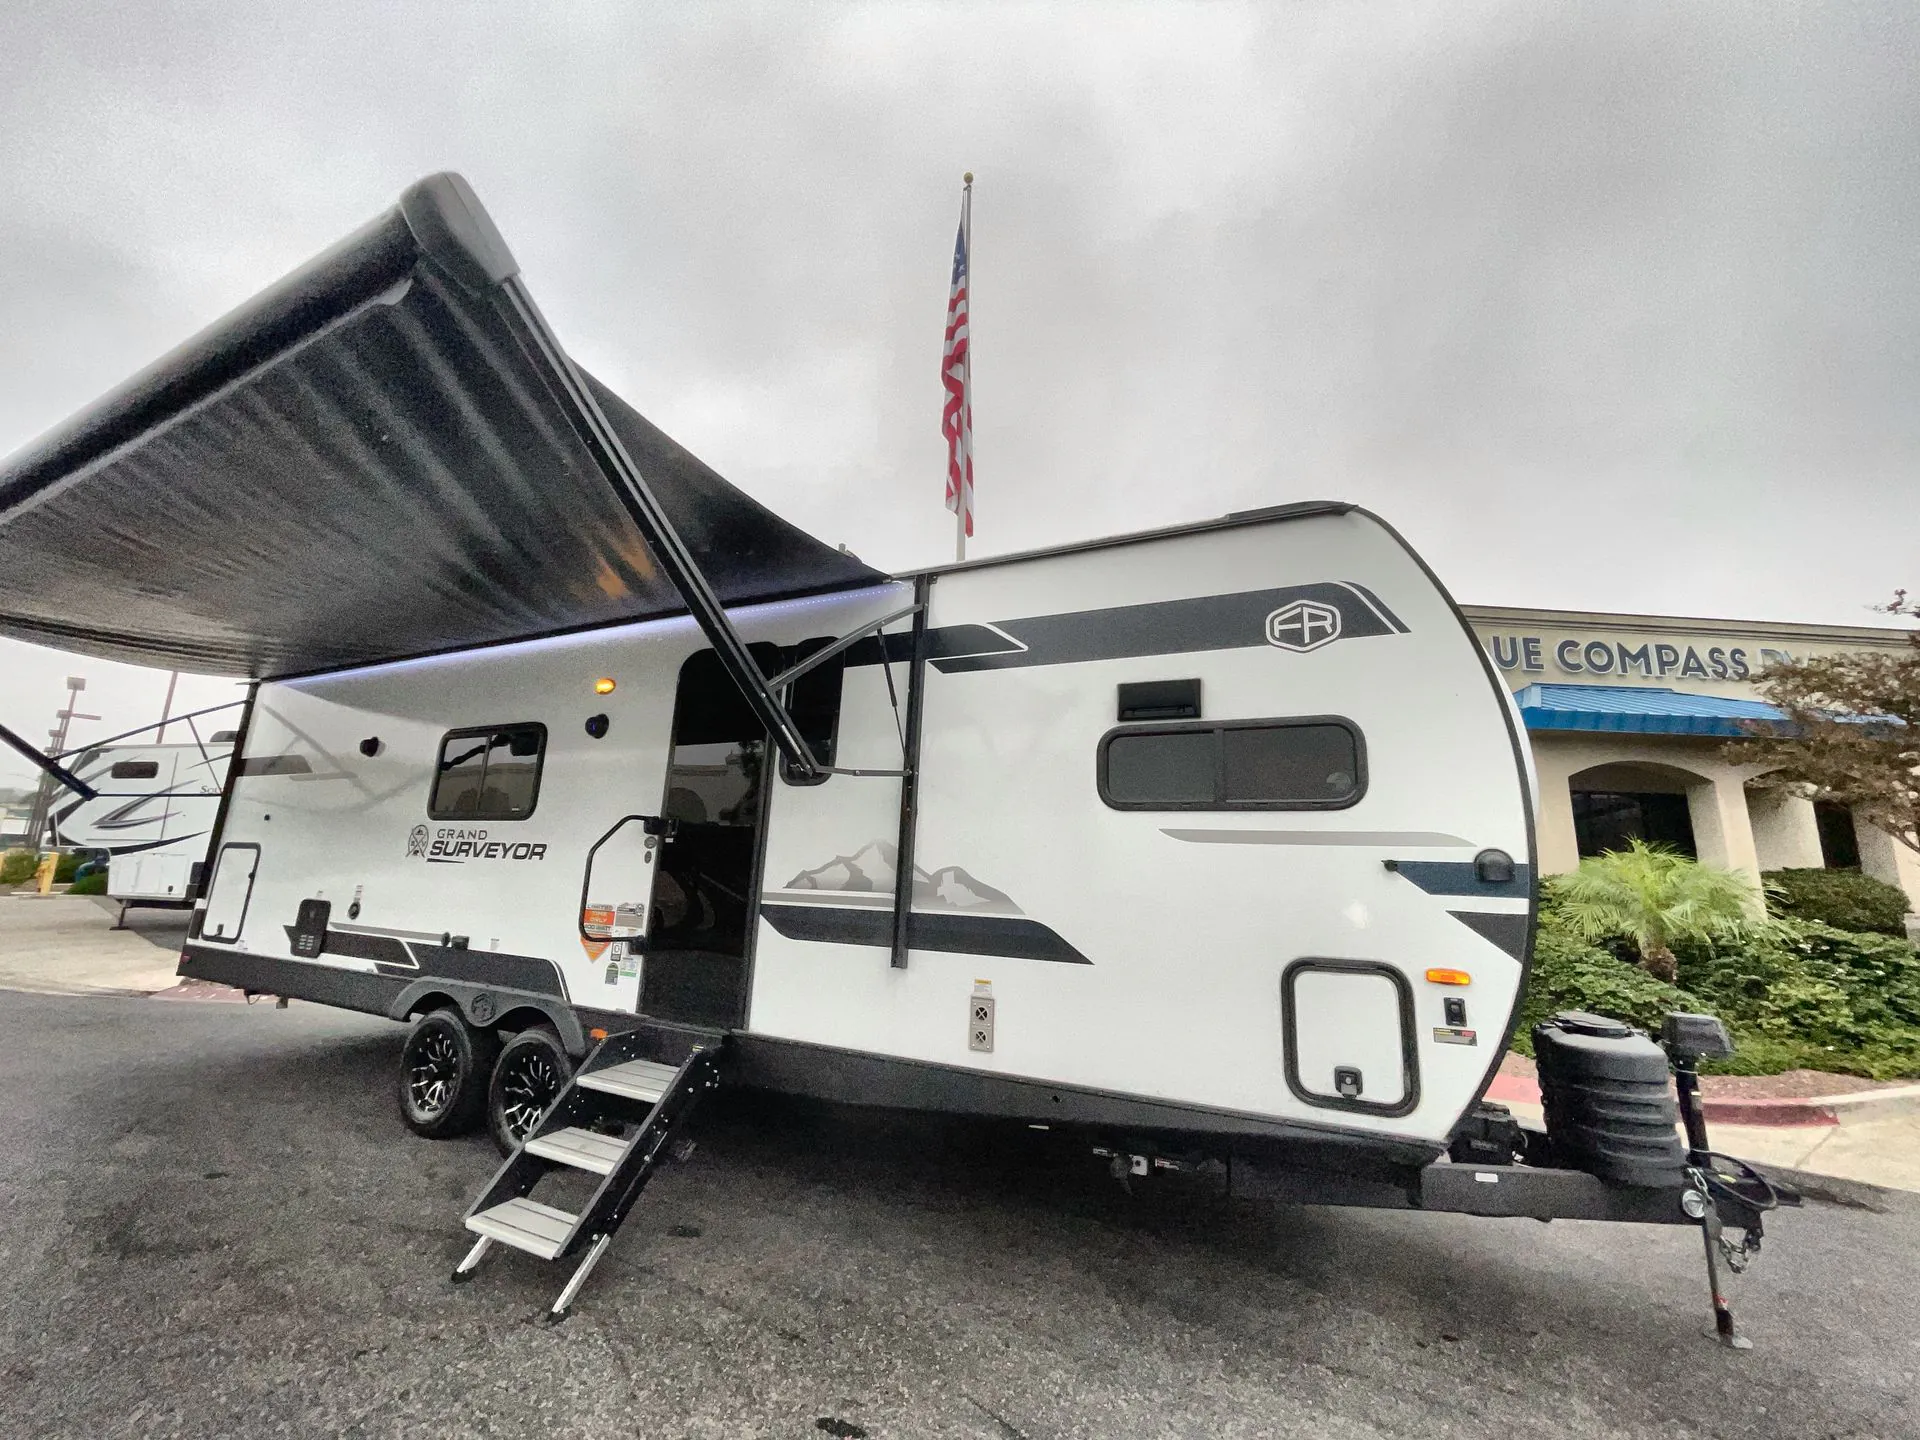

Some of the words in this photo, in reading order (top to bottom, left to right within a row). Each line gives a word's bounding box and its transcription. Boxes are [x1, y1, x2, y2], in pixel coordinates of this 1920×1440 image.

[1491, 635, 1545, 670] UE
[1557, 639, 1751, 680] COMPASS
[437, 828, 487, 840] GRAND
[430, 841, 547, 860] SURVEYOR
